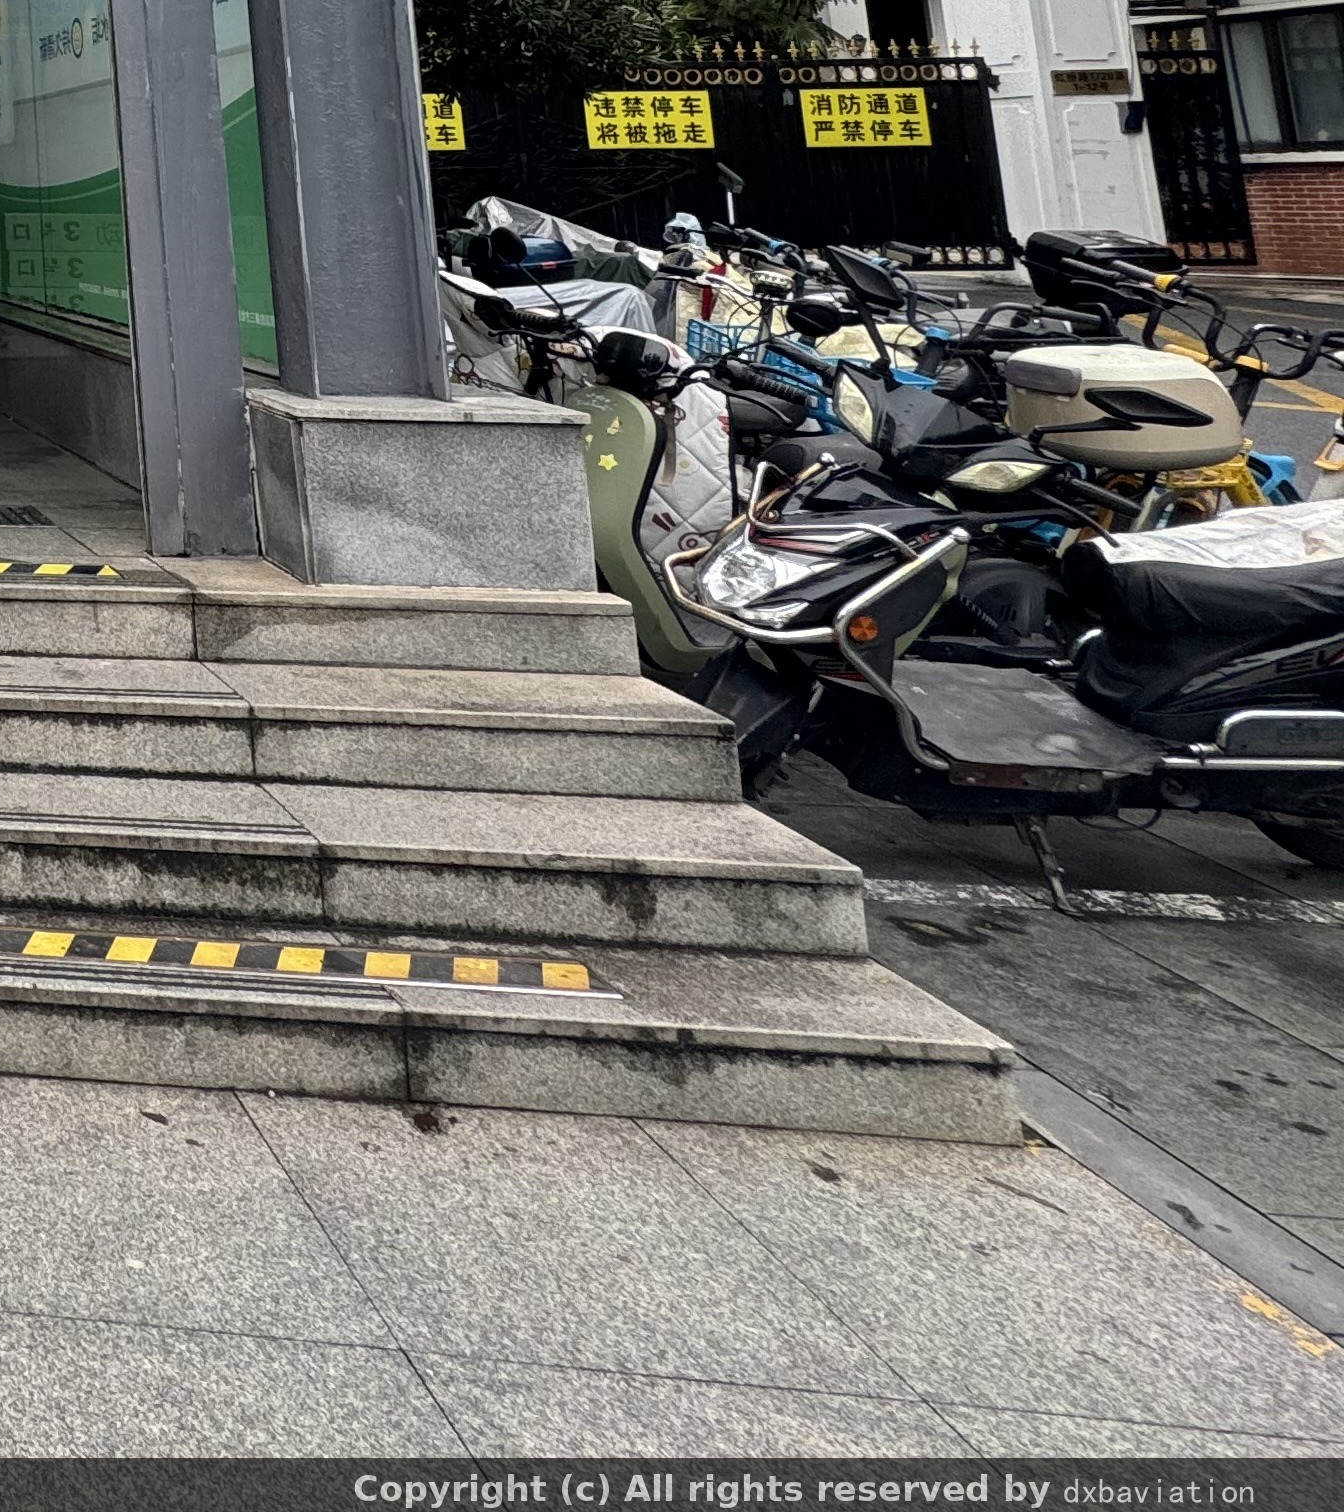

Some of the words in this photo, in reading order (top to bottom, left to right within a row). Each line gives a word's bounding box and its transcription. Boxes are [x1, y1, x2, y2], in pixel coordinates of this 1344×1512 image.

[422, 97, 455, 120] 道
[593, 96, 703, 118] 违禁停车
[809, 93, 920, 115] 消防通道
[424, 124, 458, 145] 车
[596, 122, 707, 145] 将被拖走
[813, 119, 923, 142] 严禁停车
